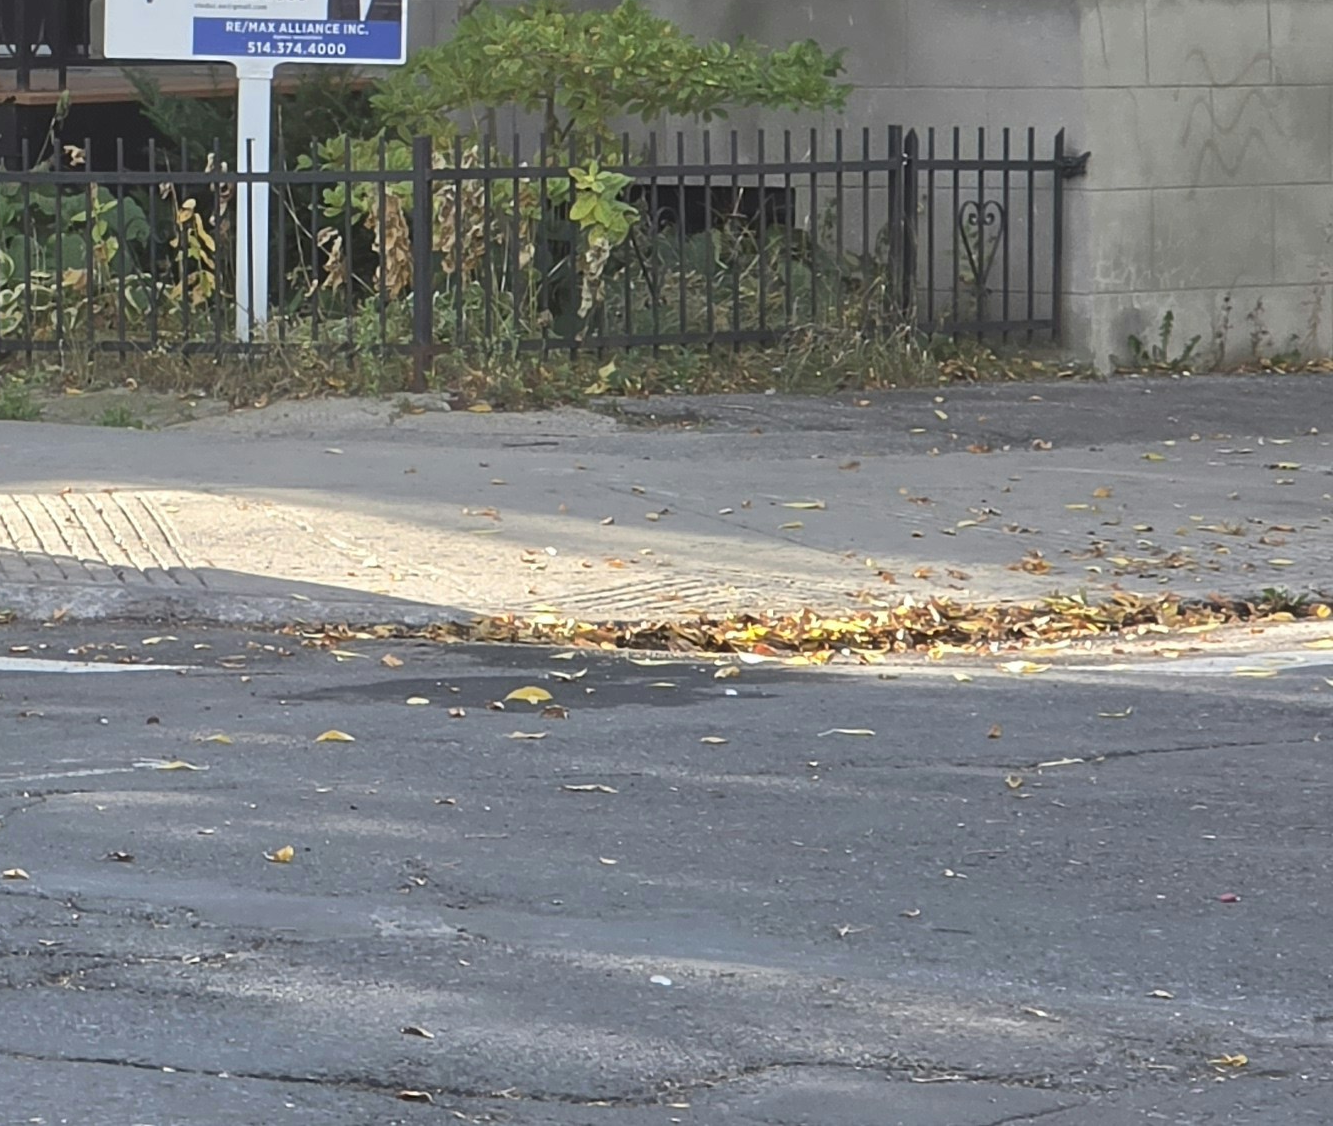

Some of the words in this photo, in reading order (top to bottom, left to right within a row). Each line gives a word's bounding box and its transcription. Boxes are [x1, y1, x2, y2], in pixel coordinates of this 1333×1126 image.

[225, 21, 276, 34] RE/MAX
[278, 22, 340, 35] ALLIANCE
[343, 23, 369, 36] INC.
[247, 41, 347, 56] 514.374.4000
